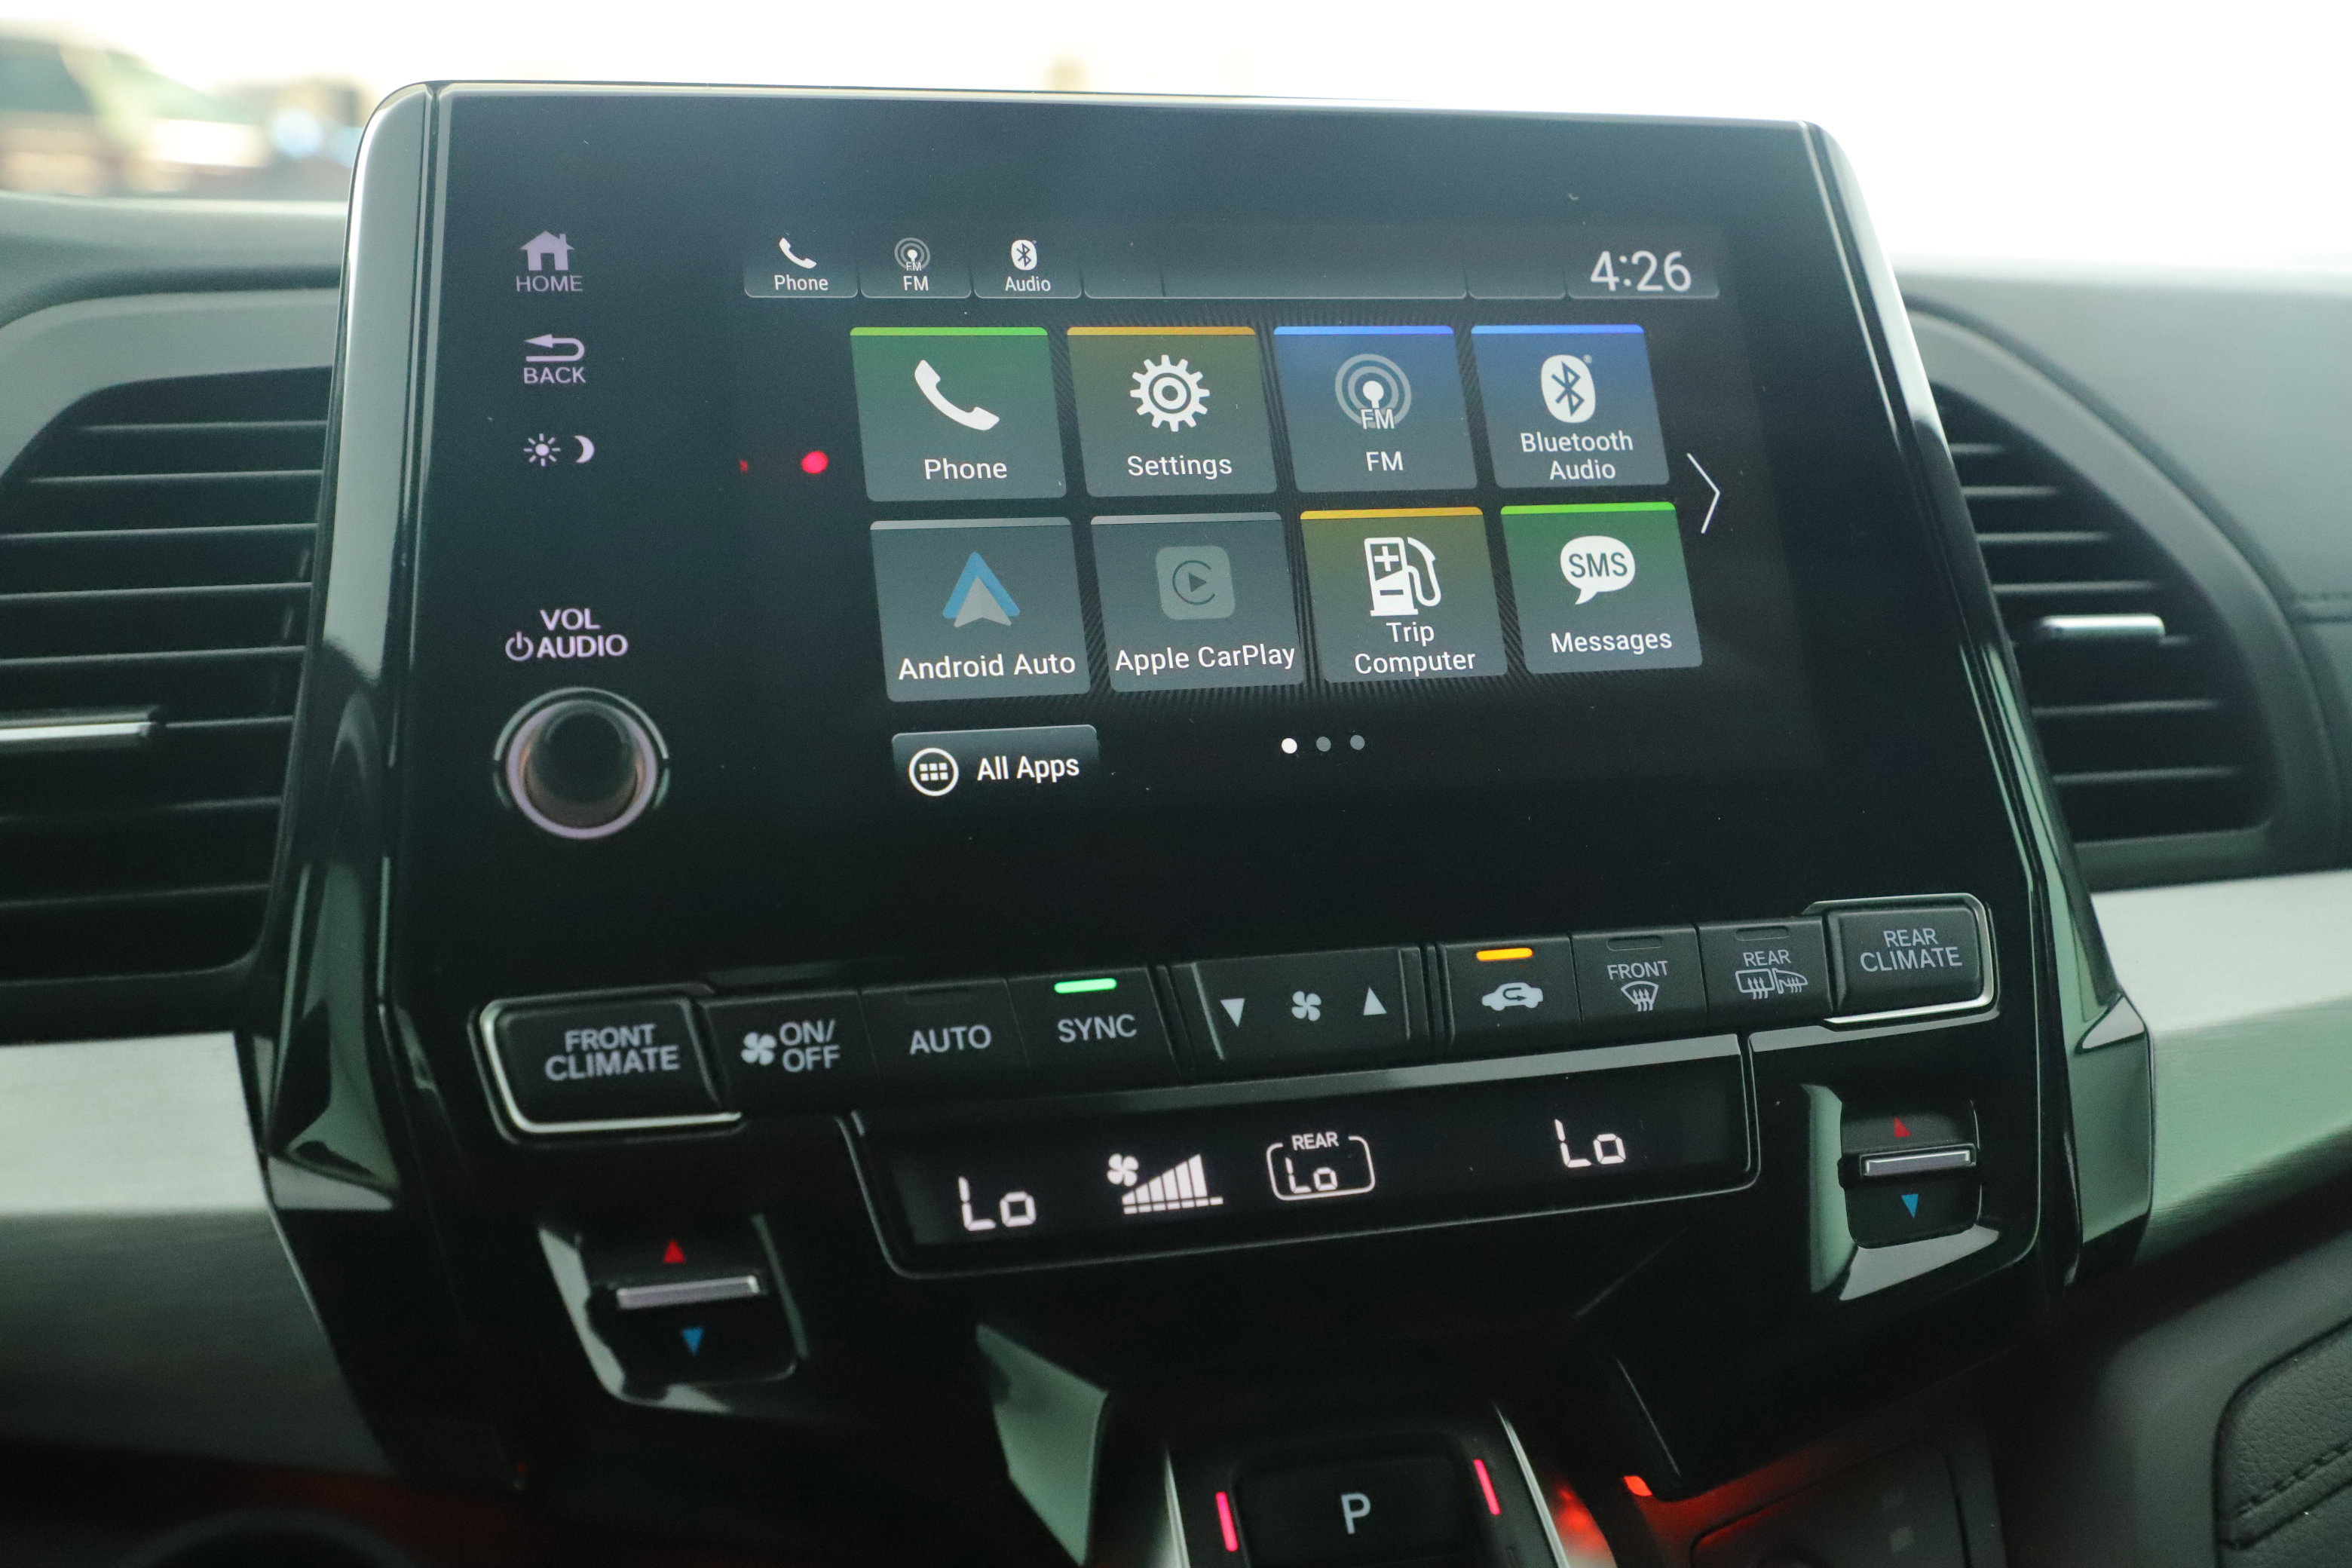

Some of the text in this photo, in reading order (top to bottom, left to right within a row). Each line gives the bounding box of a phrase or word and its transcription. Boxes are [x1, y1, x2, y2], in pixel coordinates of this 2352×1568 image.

[905, 261, 922, 271] FM
[1590, 250, 1692, 292] 4:26
[516, 274, 583, 292] HOME
[774, 274, 828, 291] Phone
[903, 275, 929, 291] FM
[1005, 275, 1052, 292] Audio
[523, 366, 586, 384] BACK
[1361, 408, 1395, 430] FM
[1521, 430, 1634, 452] Bluetooth
[924, 458, 1007, 480] Phone
[1127, 455, 1233, 480] Settings
[1366, 451, 1404, 472] FM
[1549, 458, 1616, 480] Audio
[1569, 552, 1628, 577] SMS
[540, 608, 601, 631] VOL
[536, 634, 629, 658] AUDIO
[1386, 621, 1435, 647] Trip
[1551, 632, 1673, 657] Messages
[898, 654, 1076, 680] Android Auto
[1115, 643, 1295, 676] Apple CarPlay
[1355, 651, 1476, 677] Computer
[977, 755, 1080, 784] All Apps
[1882, 928, 1938, 947] REAR
[1742, 949, 1792, 967] REAR
[1860, 942, 1963, 972] CLIMATE
[1606, 960, 1668, 980] FRONT
[565, 1023, 656, 1051] FRONT
[779, 1019, 835, 1046] ON/
[909, 1024, 991, 1055] AUTO
[1057, 1013, 1137, 1043] SYNC
[544, 1046, 681, 1082] CLIMATE
[782, 1046, 840, 1073] OFF
[1291, 1131, 1340, 1151] REAR
[1554, 1119, 1626, 1168] Lo
[1285, 1157, 1338, 1194] Lo
[958, 1177, 1037, 1232] Lo
[1341, 1493, 1371, 1534] P
